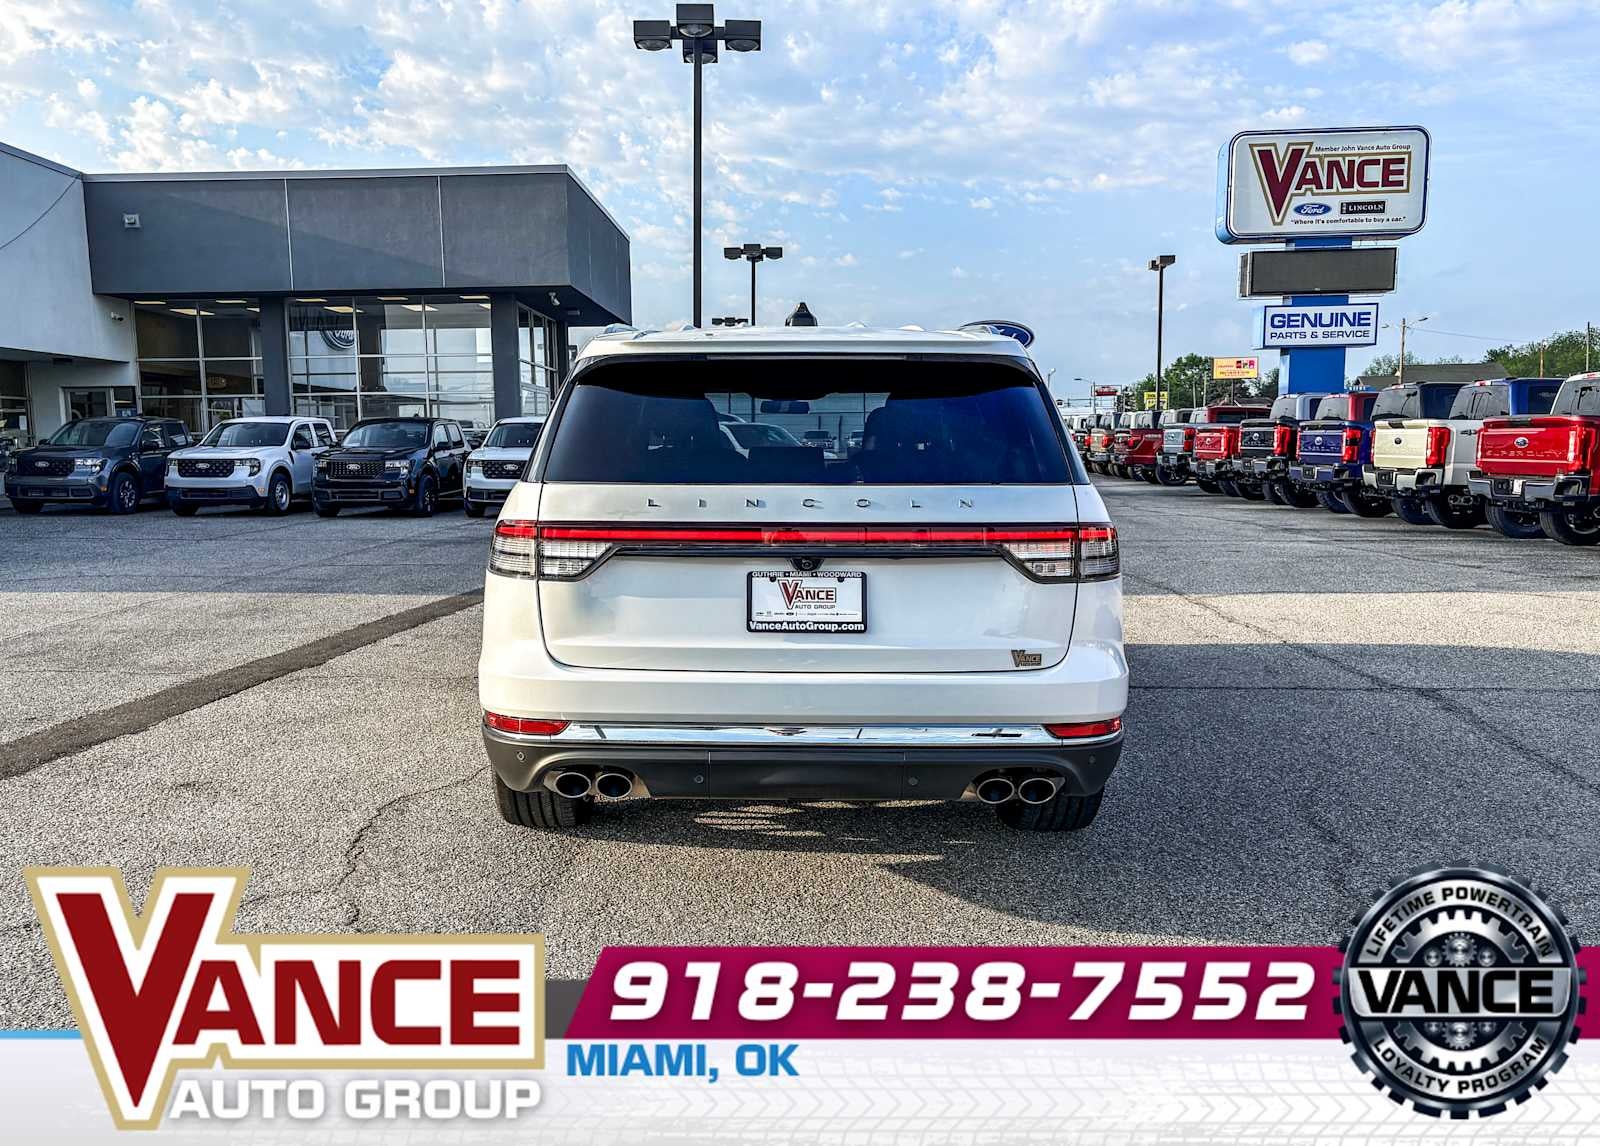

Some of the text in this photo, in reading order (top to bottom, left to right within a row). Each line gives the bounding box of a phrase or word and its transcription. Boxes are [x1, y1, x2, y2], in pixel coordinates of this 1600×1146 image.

[1391, 143, 1411, 151] Group
[1256, 148, 1406, 219] VANCE
[1300, 204, 1324, 214] Ford
[1348, 203, 1384, 211] LINCOLN
[1270, 312, 1372, 328] GENUINE
[1270, 329, 1370, 340] PARTS & SERVICE
[647, 498, 974, 508] LINCOLN
[780, 581, 835, 607] VANCE
[749, 621, 865, 632] VanceAutoGroup.com
[1011, 650, 1041, 667] VANCE
